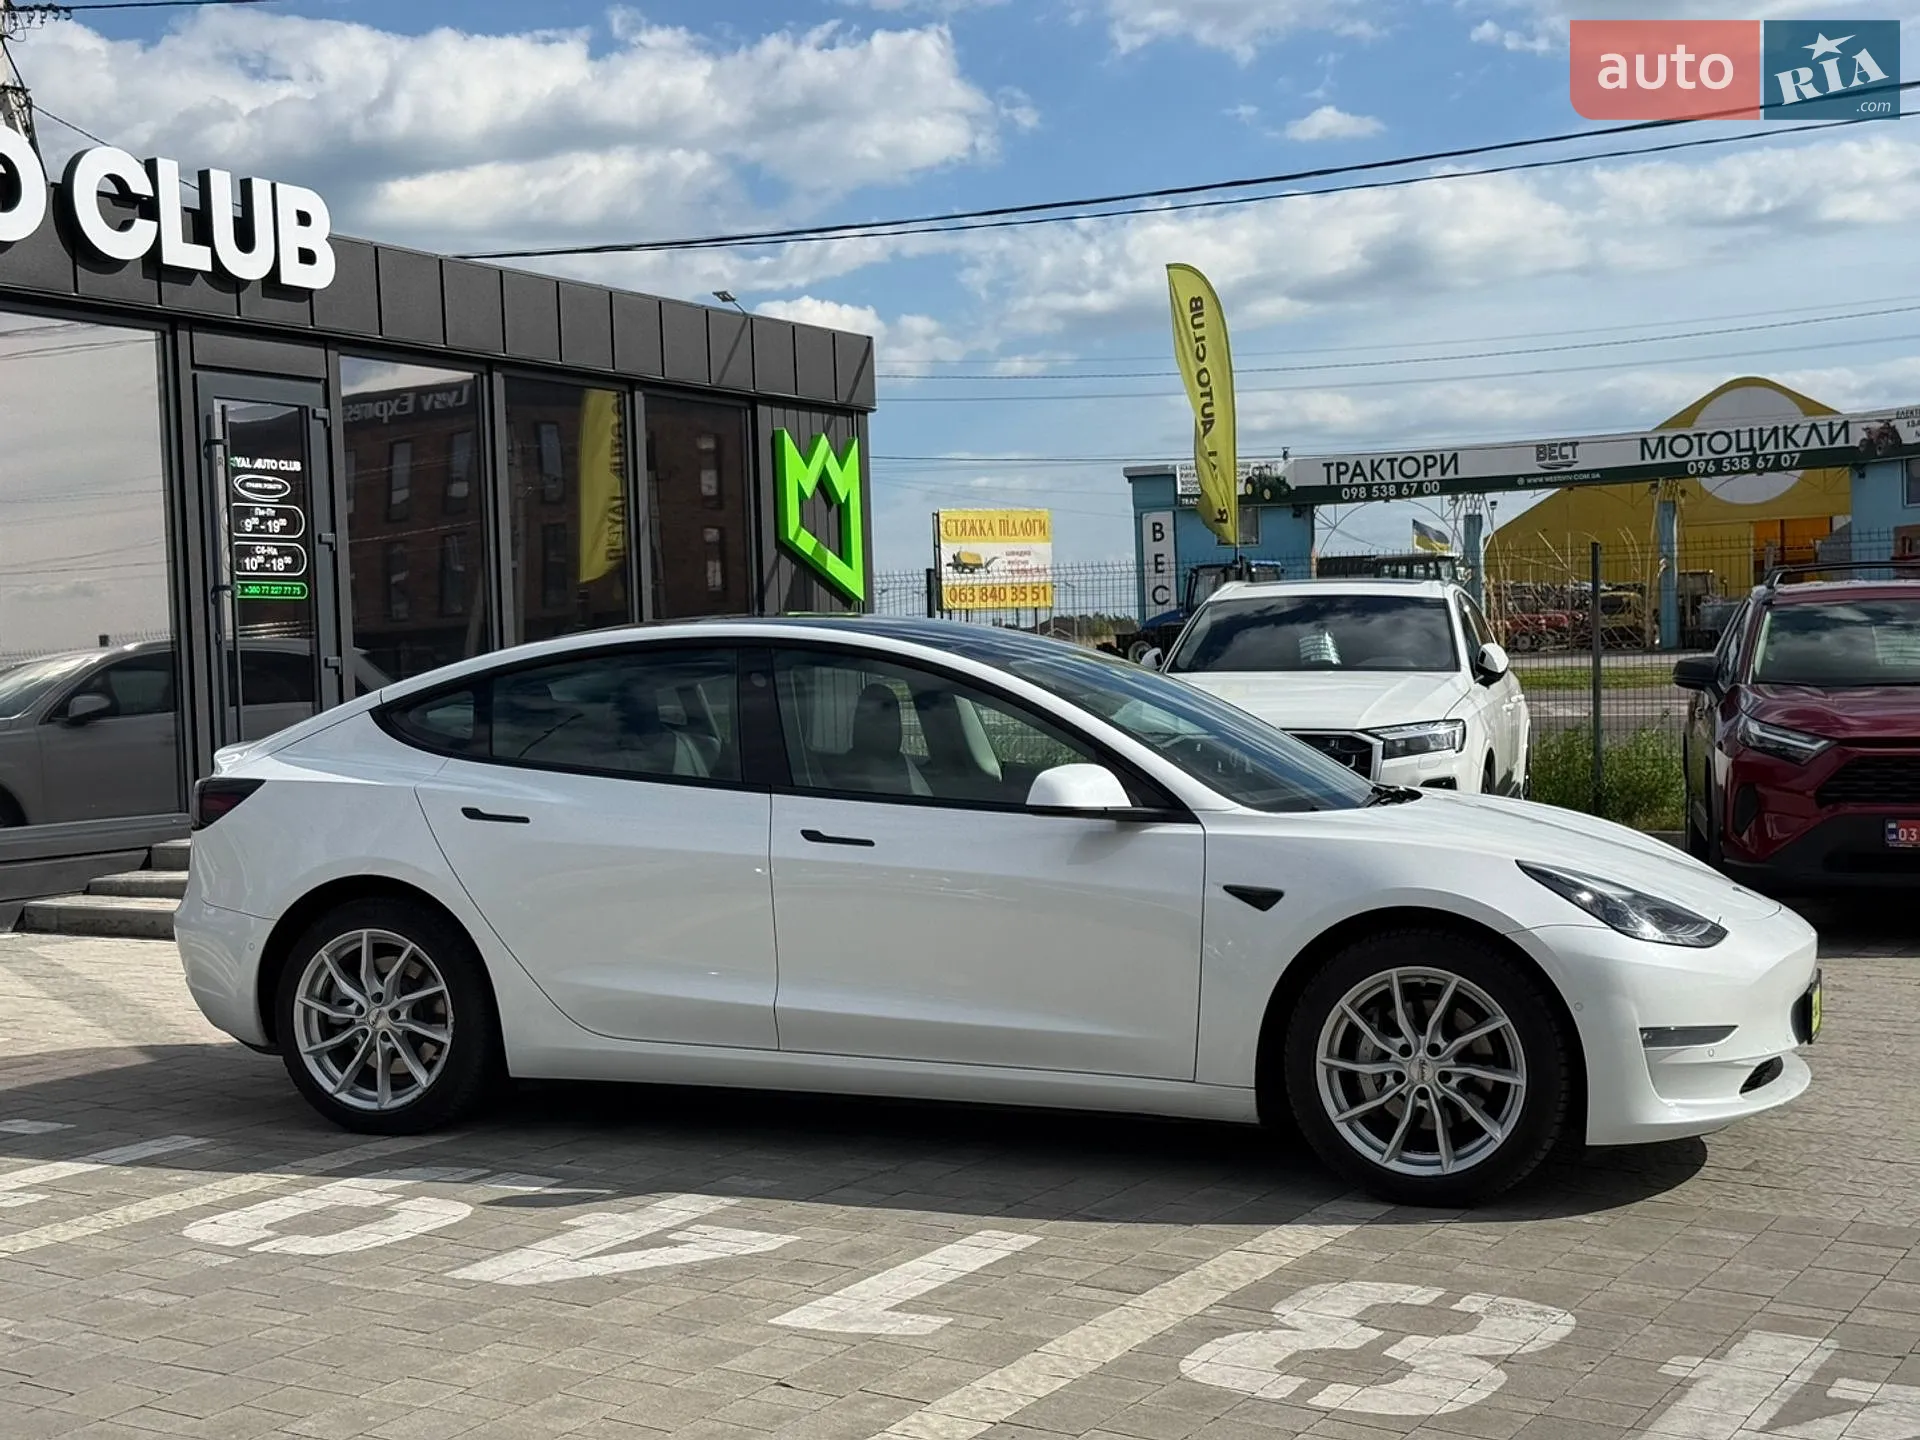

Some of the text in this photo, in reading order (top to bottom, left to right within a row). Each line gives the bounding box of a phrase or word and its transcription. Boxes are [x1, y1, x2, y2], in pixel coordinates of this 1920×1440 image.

[72, 146, 336, 290] CLUB
[1640, 420, 1849, 461] МОТОЦИКЛИ
[1536, 441, 1579, 462] ВЕСТ
[254, 459, 278, 470] AUTO
[279, 460, 302, 471] CLUB
[1322, 452, 1459, 485] ТРАКТОРИ
[1687, 453, 1800, 475] 096 538 67 07
[1342, 481, 1440, 500] 098 538 67 00
[945, 519, 994, 536] СТЯЖКА
[1151, 522, 1170, 606] ВЕС
[949, 585, 1048, 603] 063 840 35 51
